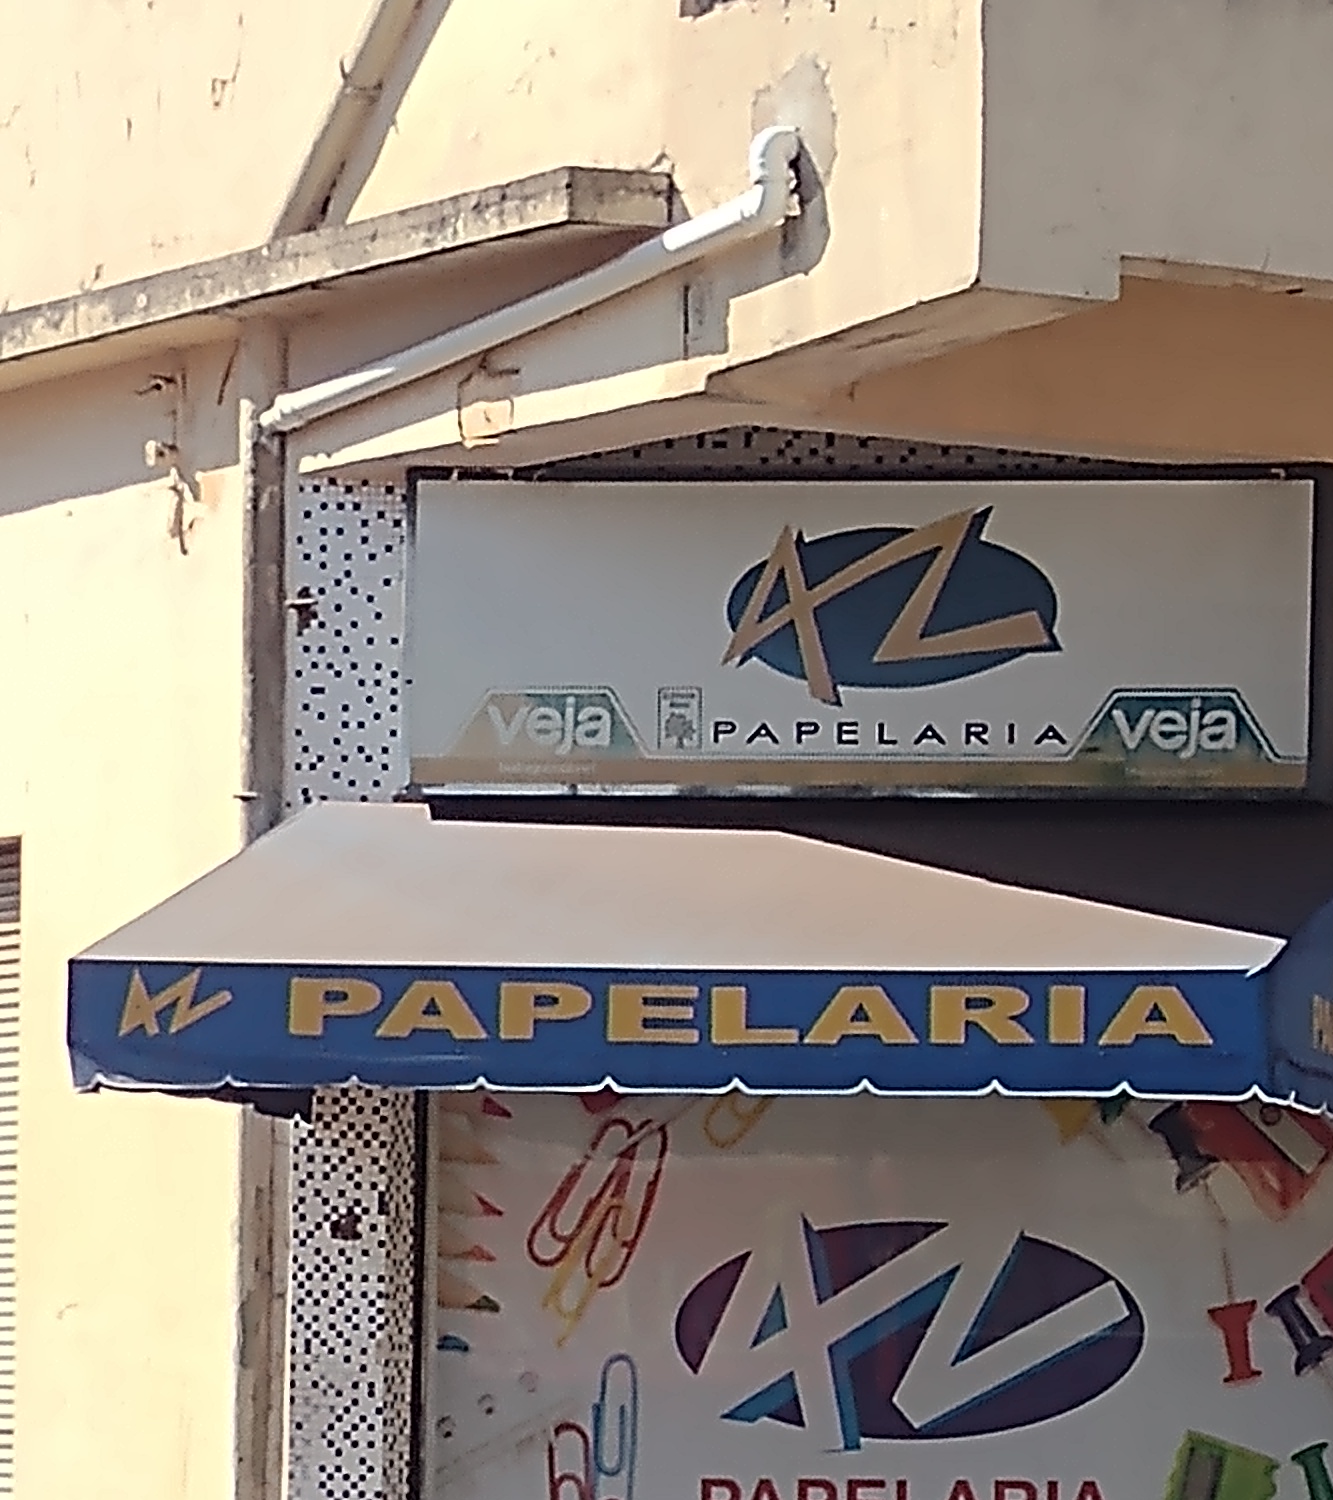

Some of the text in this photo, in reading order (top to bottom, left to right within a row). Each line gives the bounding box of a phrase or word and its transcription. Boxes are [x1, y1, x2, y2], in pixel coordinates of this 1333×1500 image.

[720, 504, 1063, 708] AZ
[487, 696, 613, 755] veja
[711, 720, 1068, 746] PAPELARIA
[1111, 696, 1238, 759] veja
[288, 976, 1214, 1047] PAPELARIA
